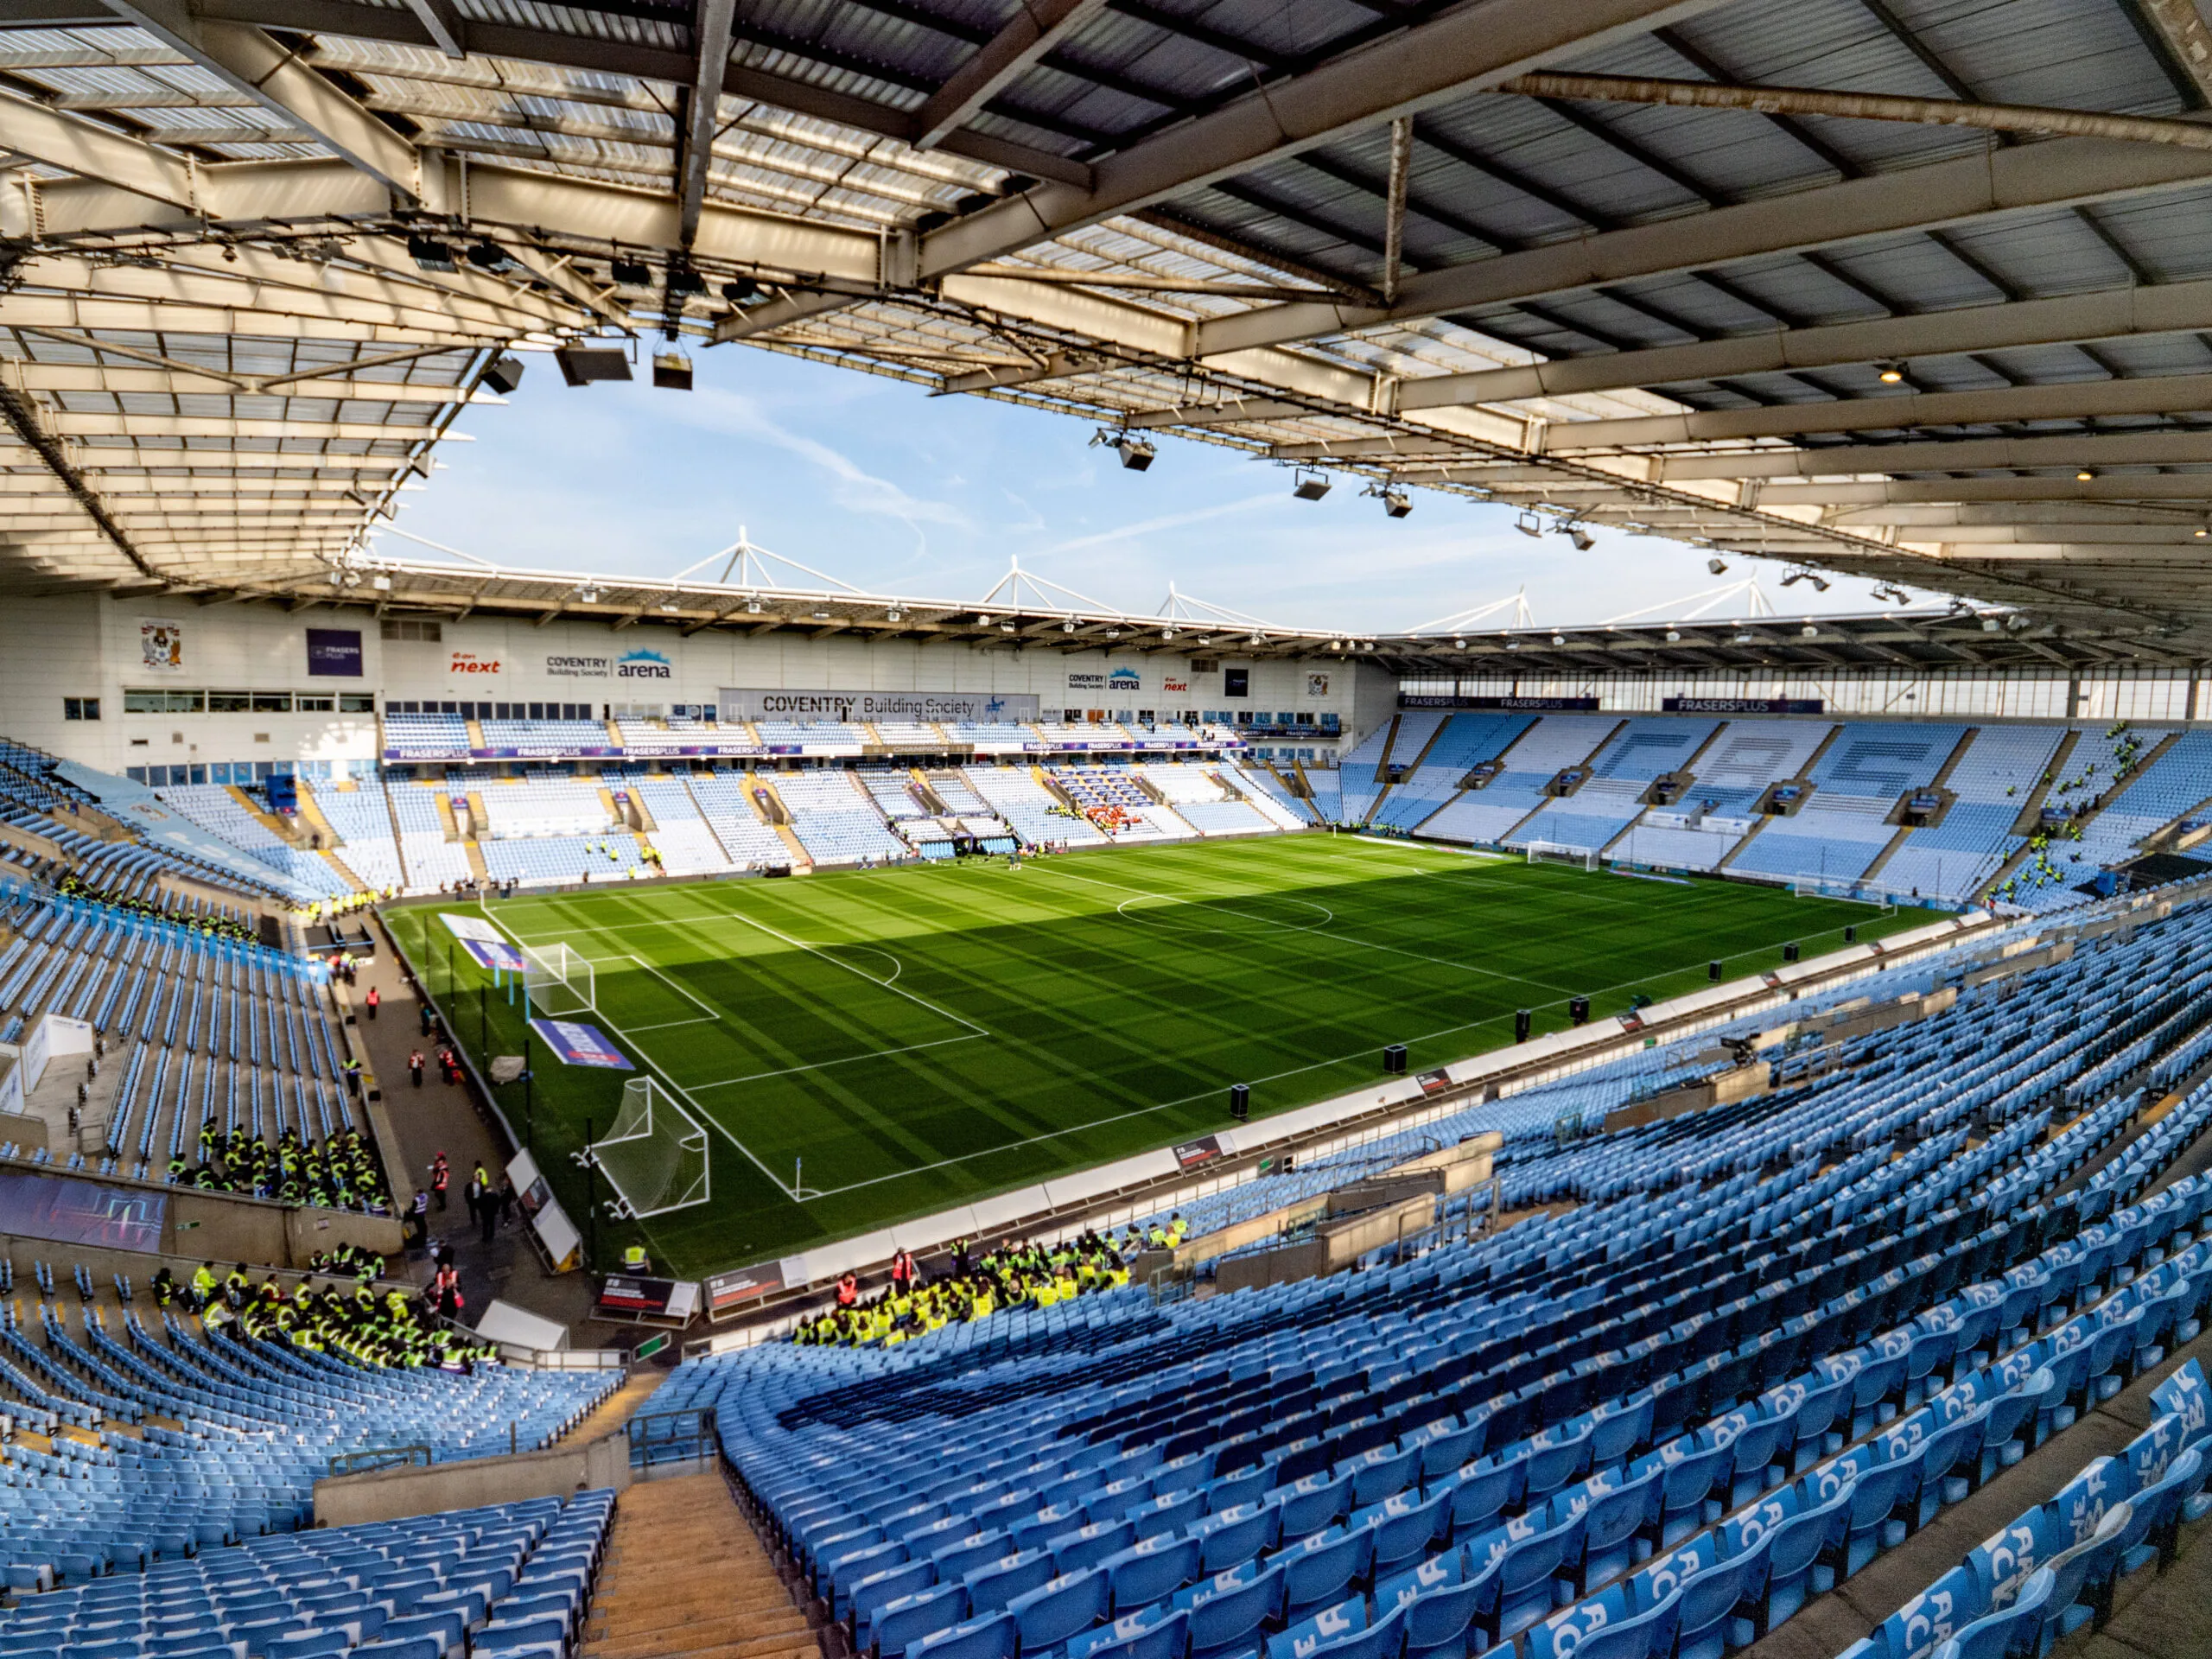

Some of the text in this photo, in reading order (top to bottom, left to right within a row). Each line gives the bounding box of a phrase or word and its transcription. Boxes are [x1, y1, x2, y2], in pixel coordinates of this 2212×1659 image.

[451, 660, 500, 674] next
[547, 656, 607, 668] COVENTRY
[547, 668, 607, 677] Building Society
[618, 664, 671, 678] arena
[1069, 674, 1103, 683] COVENTRY
[1109, 680, 1140, 690] arena
[1164, 683, 1187, 691] next
[763, 696, 975, 717] COVENTRY Building Society
[1678, 700, 1770, 712] FRASERSPLUS
